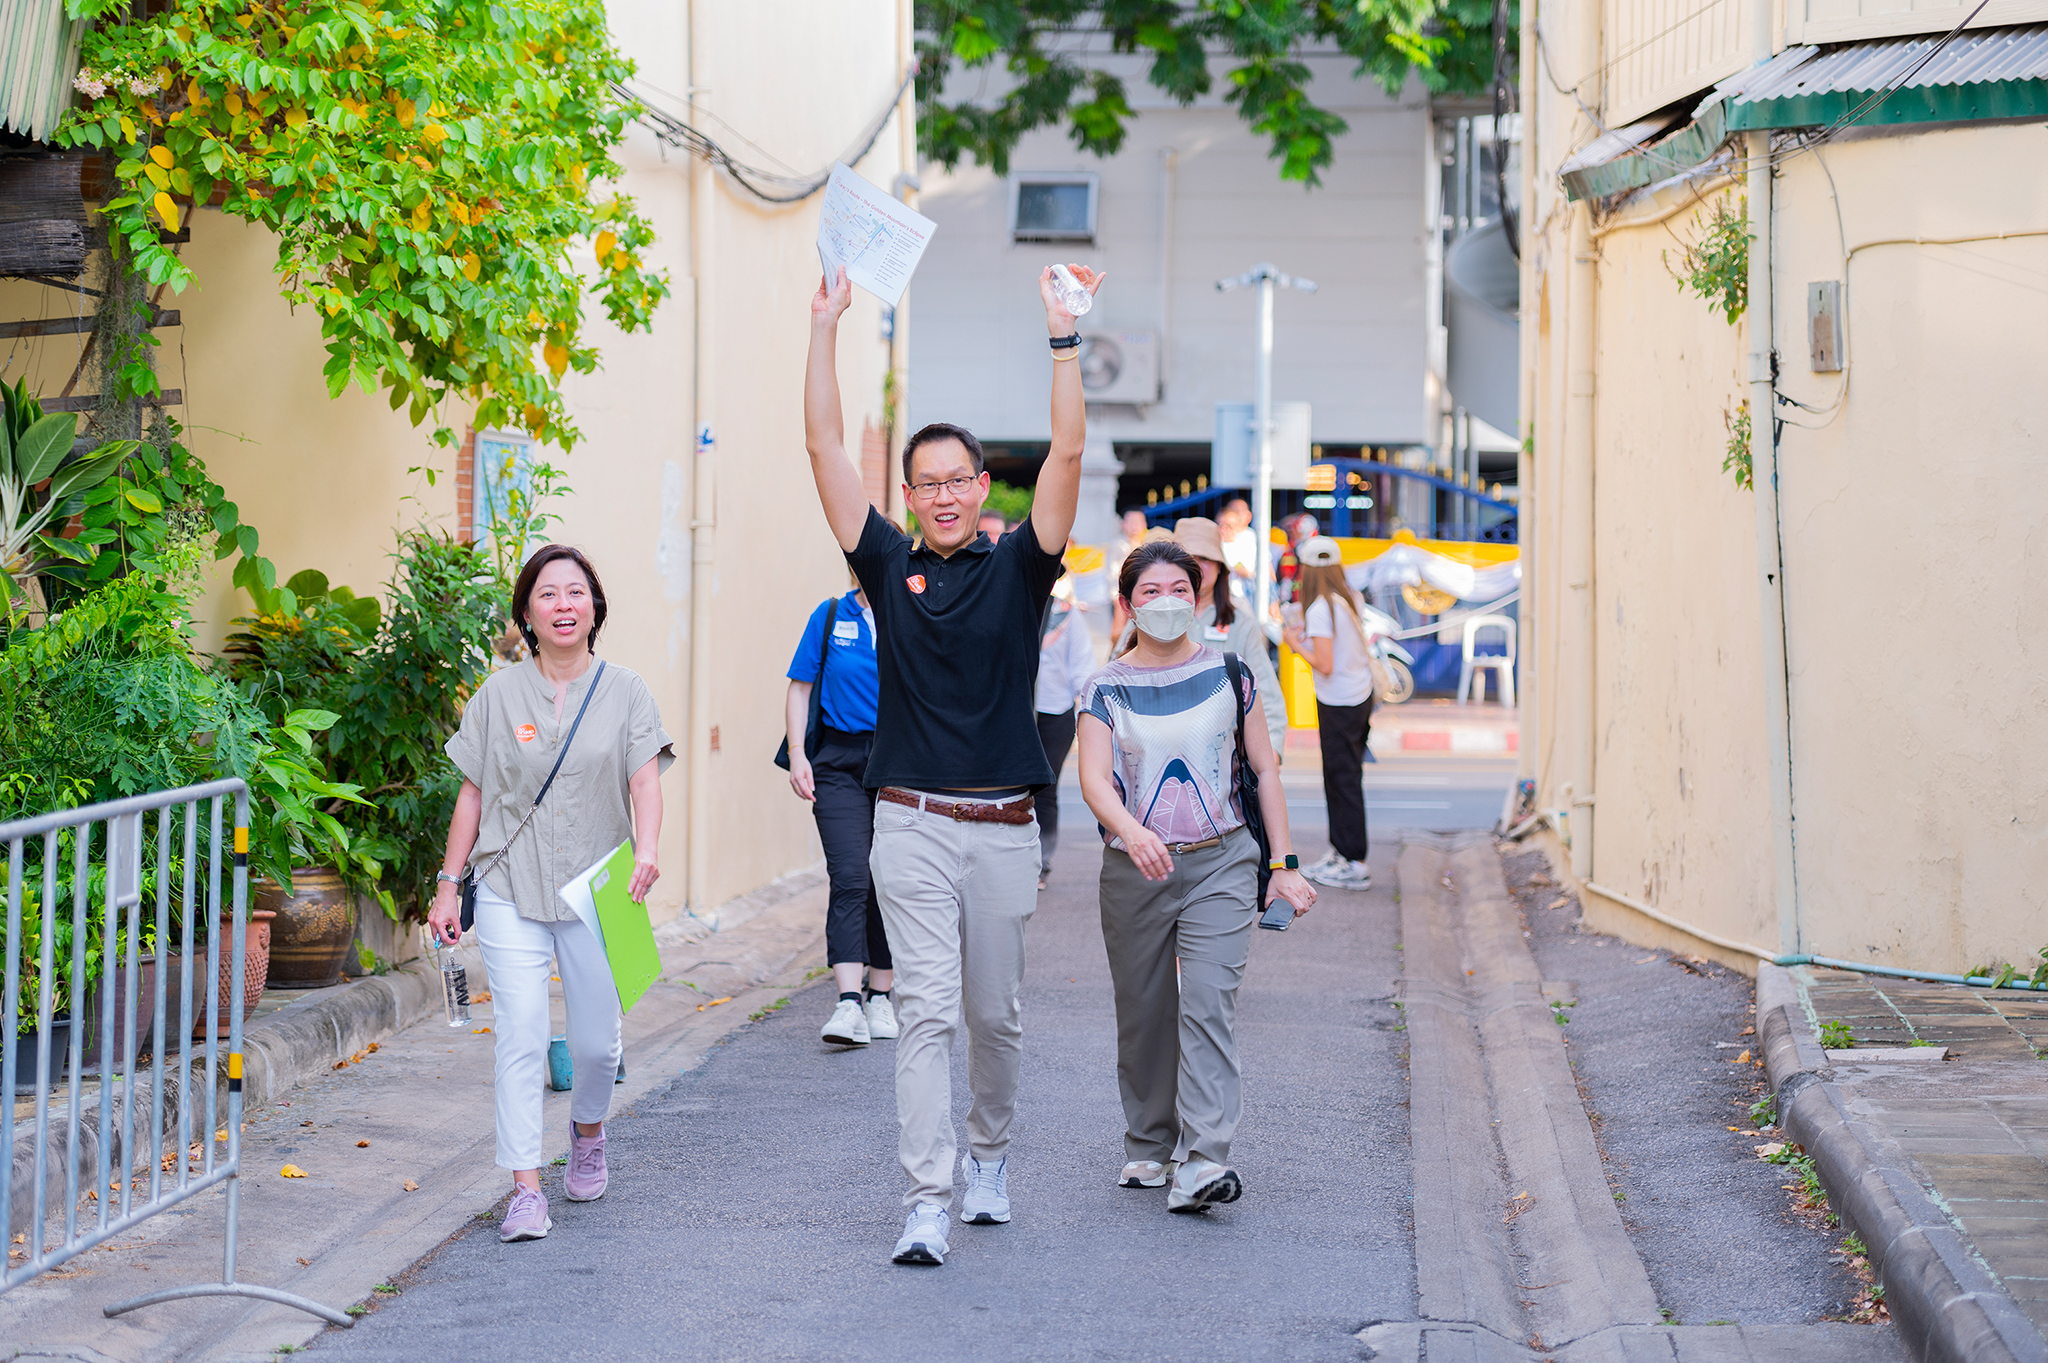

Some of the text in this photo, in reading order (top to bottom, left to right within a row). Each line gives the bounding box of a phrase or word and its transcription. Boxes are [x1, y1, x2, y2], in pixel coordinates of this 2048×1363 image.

[863, 199, 871, 207] The
[870, 204, 887, 217] Golden
[886, 214, 909, 231] Mountain's
[909, 228, 925, 240] Eclipse
